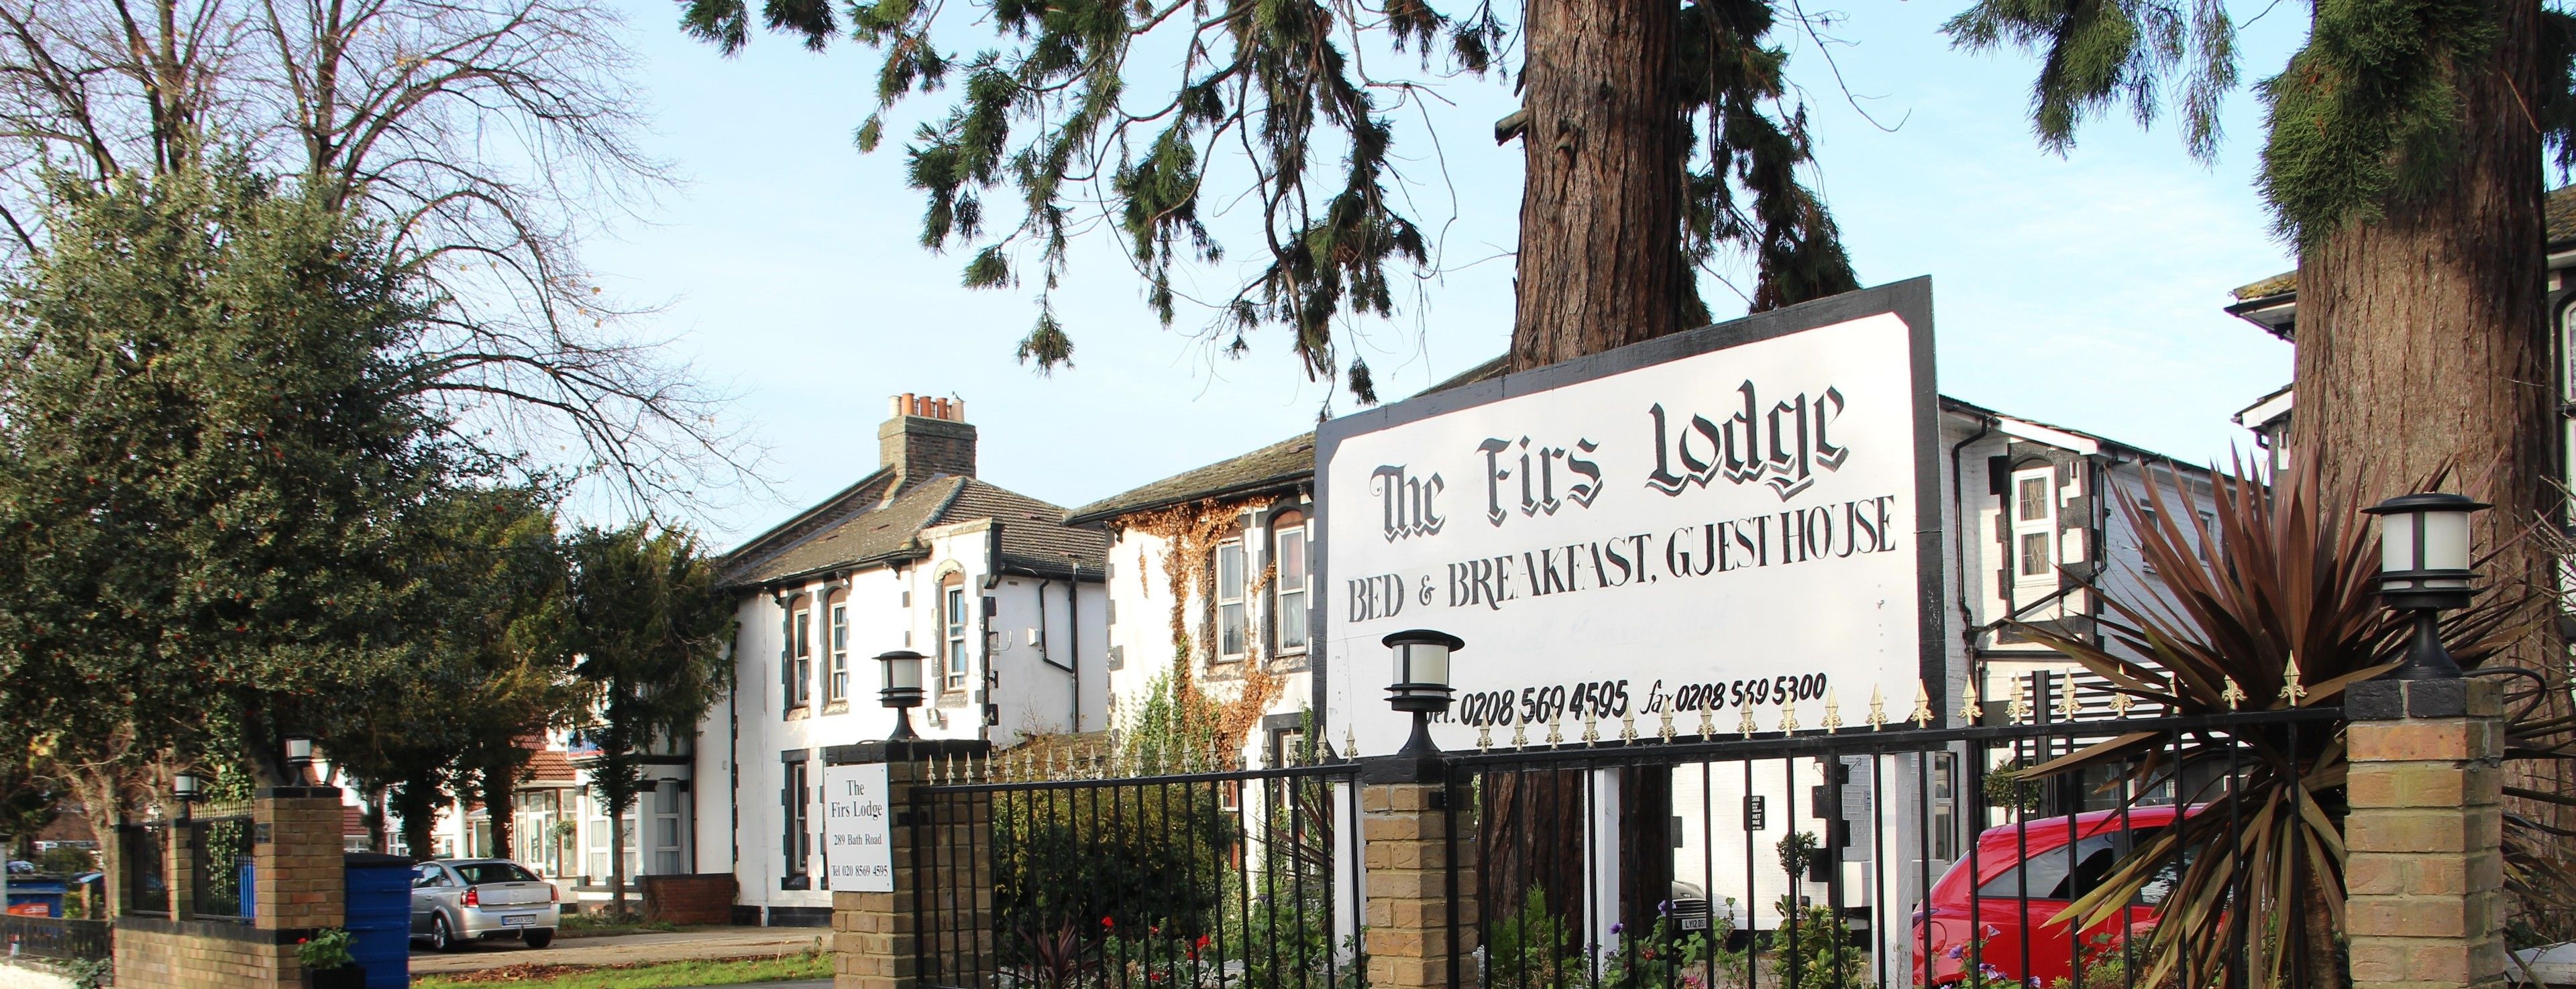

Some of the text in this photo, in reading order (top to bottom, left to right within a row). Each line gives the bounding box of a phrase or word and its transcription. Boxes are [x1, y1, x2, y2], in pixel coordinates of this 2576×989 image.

[1370, 379, 1849, 544] The Firs Lodge
[1347, 495, 1896, 623] BED & BREAKFAST, GUEST HOUSE
[1460, 690, 1515, 728] 0208
[1521, 685, 1565, 724] 569
[1569, 680, 1629, 721] 4595
[1675, 682, 1726, 713] 0208
[1730, 678, 1769, 707] 569
[1772, 673, 1827, 705] 5300
[847, 779, 865, 796] The
[831, 800, 883, 821] Firs Lodge
[834, 833, 882, 846] 289 Bath Road
[831, 864, 888, 876] Tel 020 8569 4595
[1685, 920, 1697, 928] LY12
